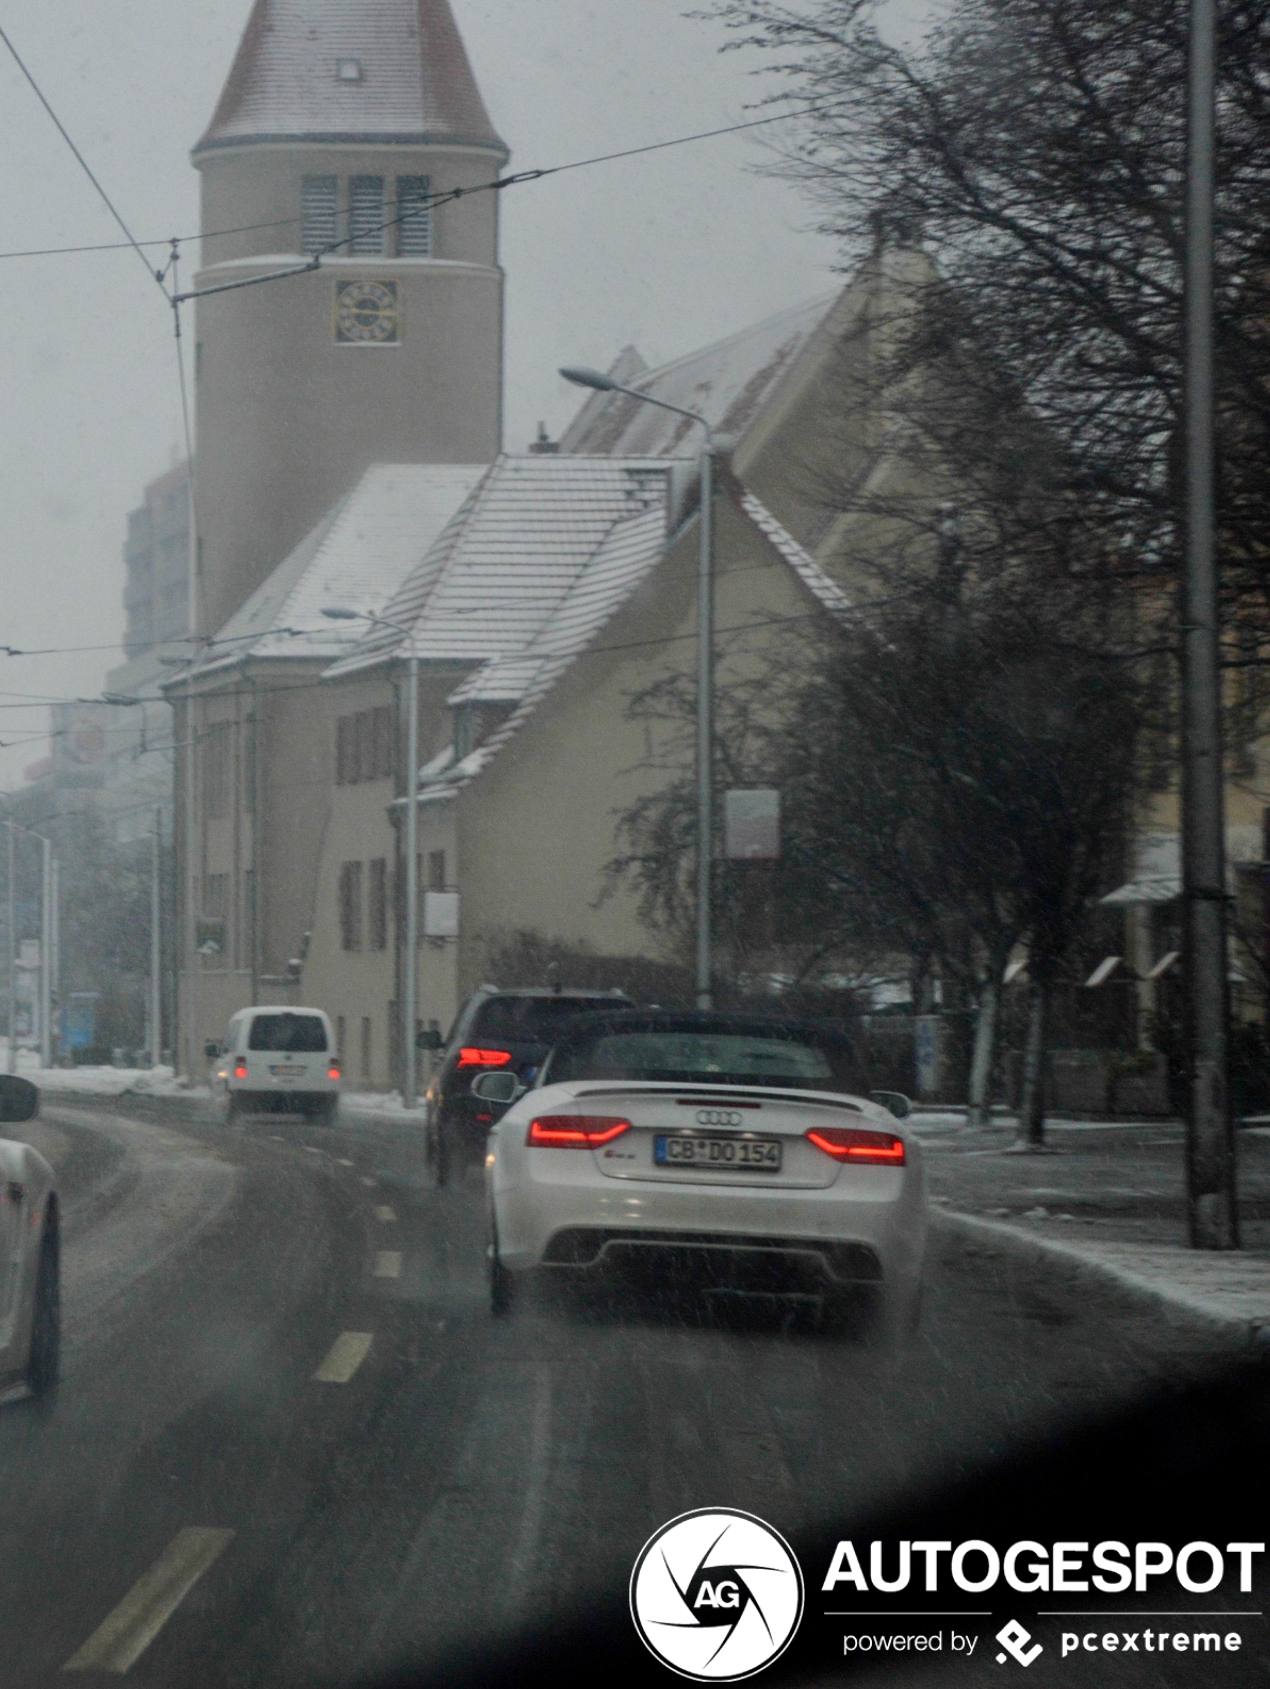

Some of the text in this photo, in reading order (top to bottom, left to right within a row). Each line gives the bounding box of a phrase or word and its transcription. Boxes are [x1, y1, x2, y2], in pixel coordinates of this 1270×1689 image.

[667, 1139, 777, 1163] CB DO 154
